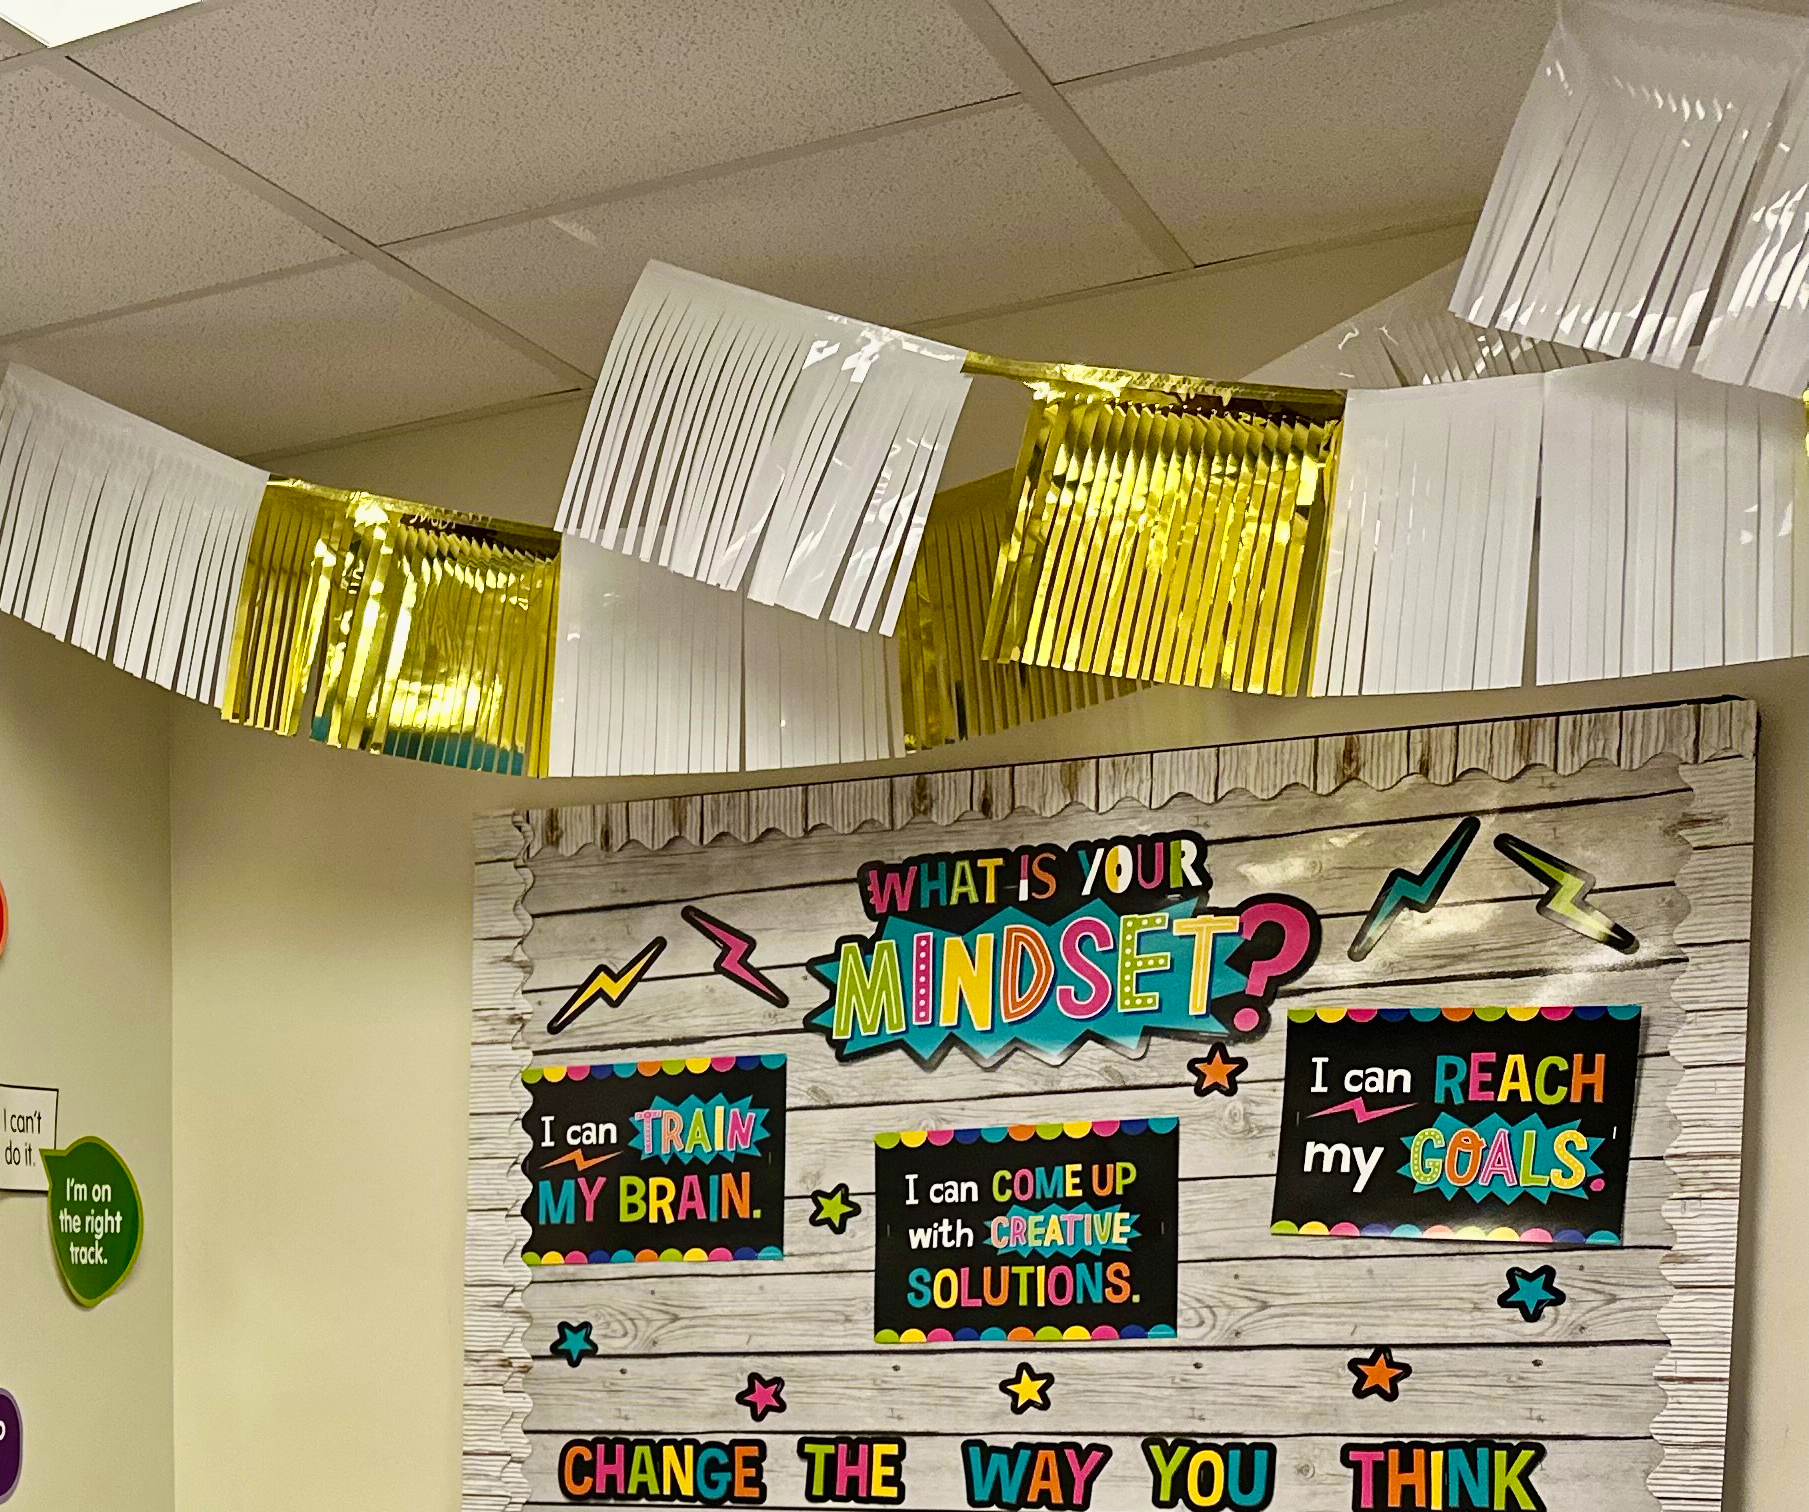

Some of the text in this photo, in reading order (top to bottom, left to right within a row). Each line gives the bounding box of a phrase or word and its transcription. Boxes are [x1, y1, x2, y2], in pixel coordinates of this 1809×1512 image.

[867, 838, 1203, 915] WHAT IS YOUR
[831, 901, 1312, 1041] MINDSET?
[1310, 1052, 1606, 1106] I can REACH
[540, 1110, 756, 1153] I can TRAIN
[904, 1162, 1137, 1206] I can COME UP
[1303, 1127, 1606, 1193] my GOALS.
[65, 1177, 111, 1203] I'm on
[538, 1172, 763, 1226] MY BRAIN.
[59, 1208, 123, 1241] the right
[908, 1211, 1133, 1251] with CREATIVE
[70, 1240, 108, 1265] track.
[907, 1261, 1141, 1309] SOLUTIONS.
[564, 1441, 1540, 1511] CHANGE THE WAY YOU THINK
